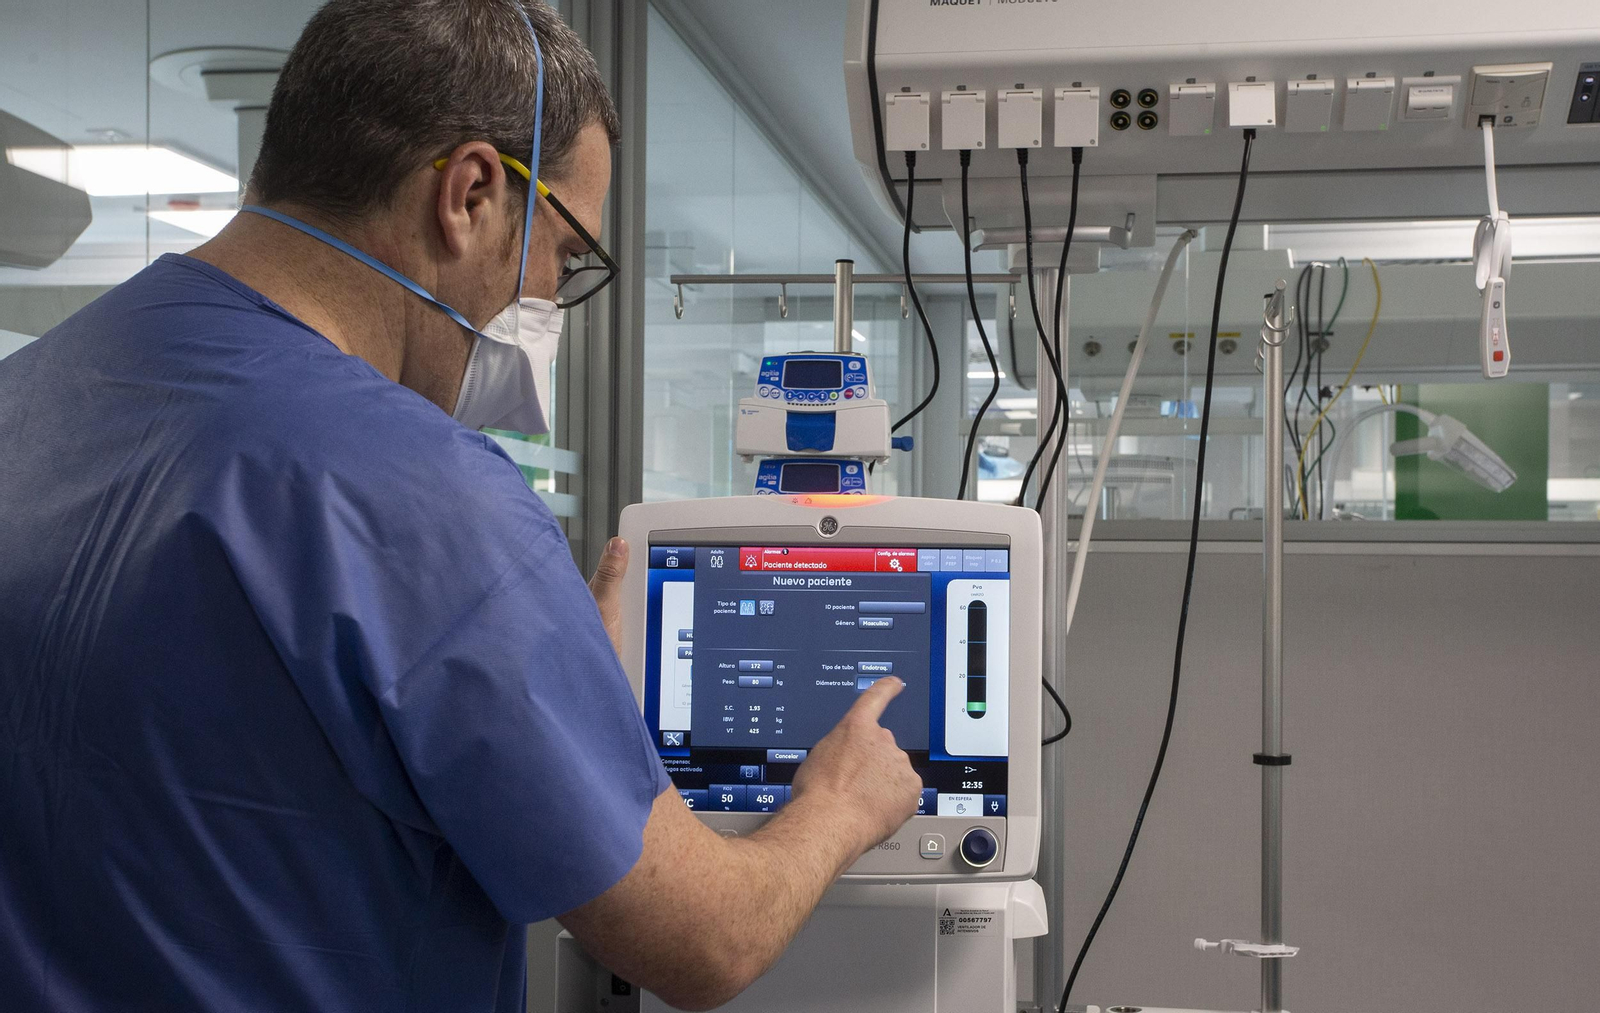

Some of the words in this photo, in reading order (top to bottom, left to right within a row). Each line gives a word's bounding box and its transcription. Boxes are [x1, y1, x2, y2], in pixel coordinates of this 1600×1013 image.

[773, 576, 805, 586] Nuevo
[808, 576, 852, 588] paciente
[722, 794, 733, 802] 50
[756, 795, 774, 803] 450
[879, 842, 900, 850] R860
